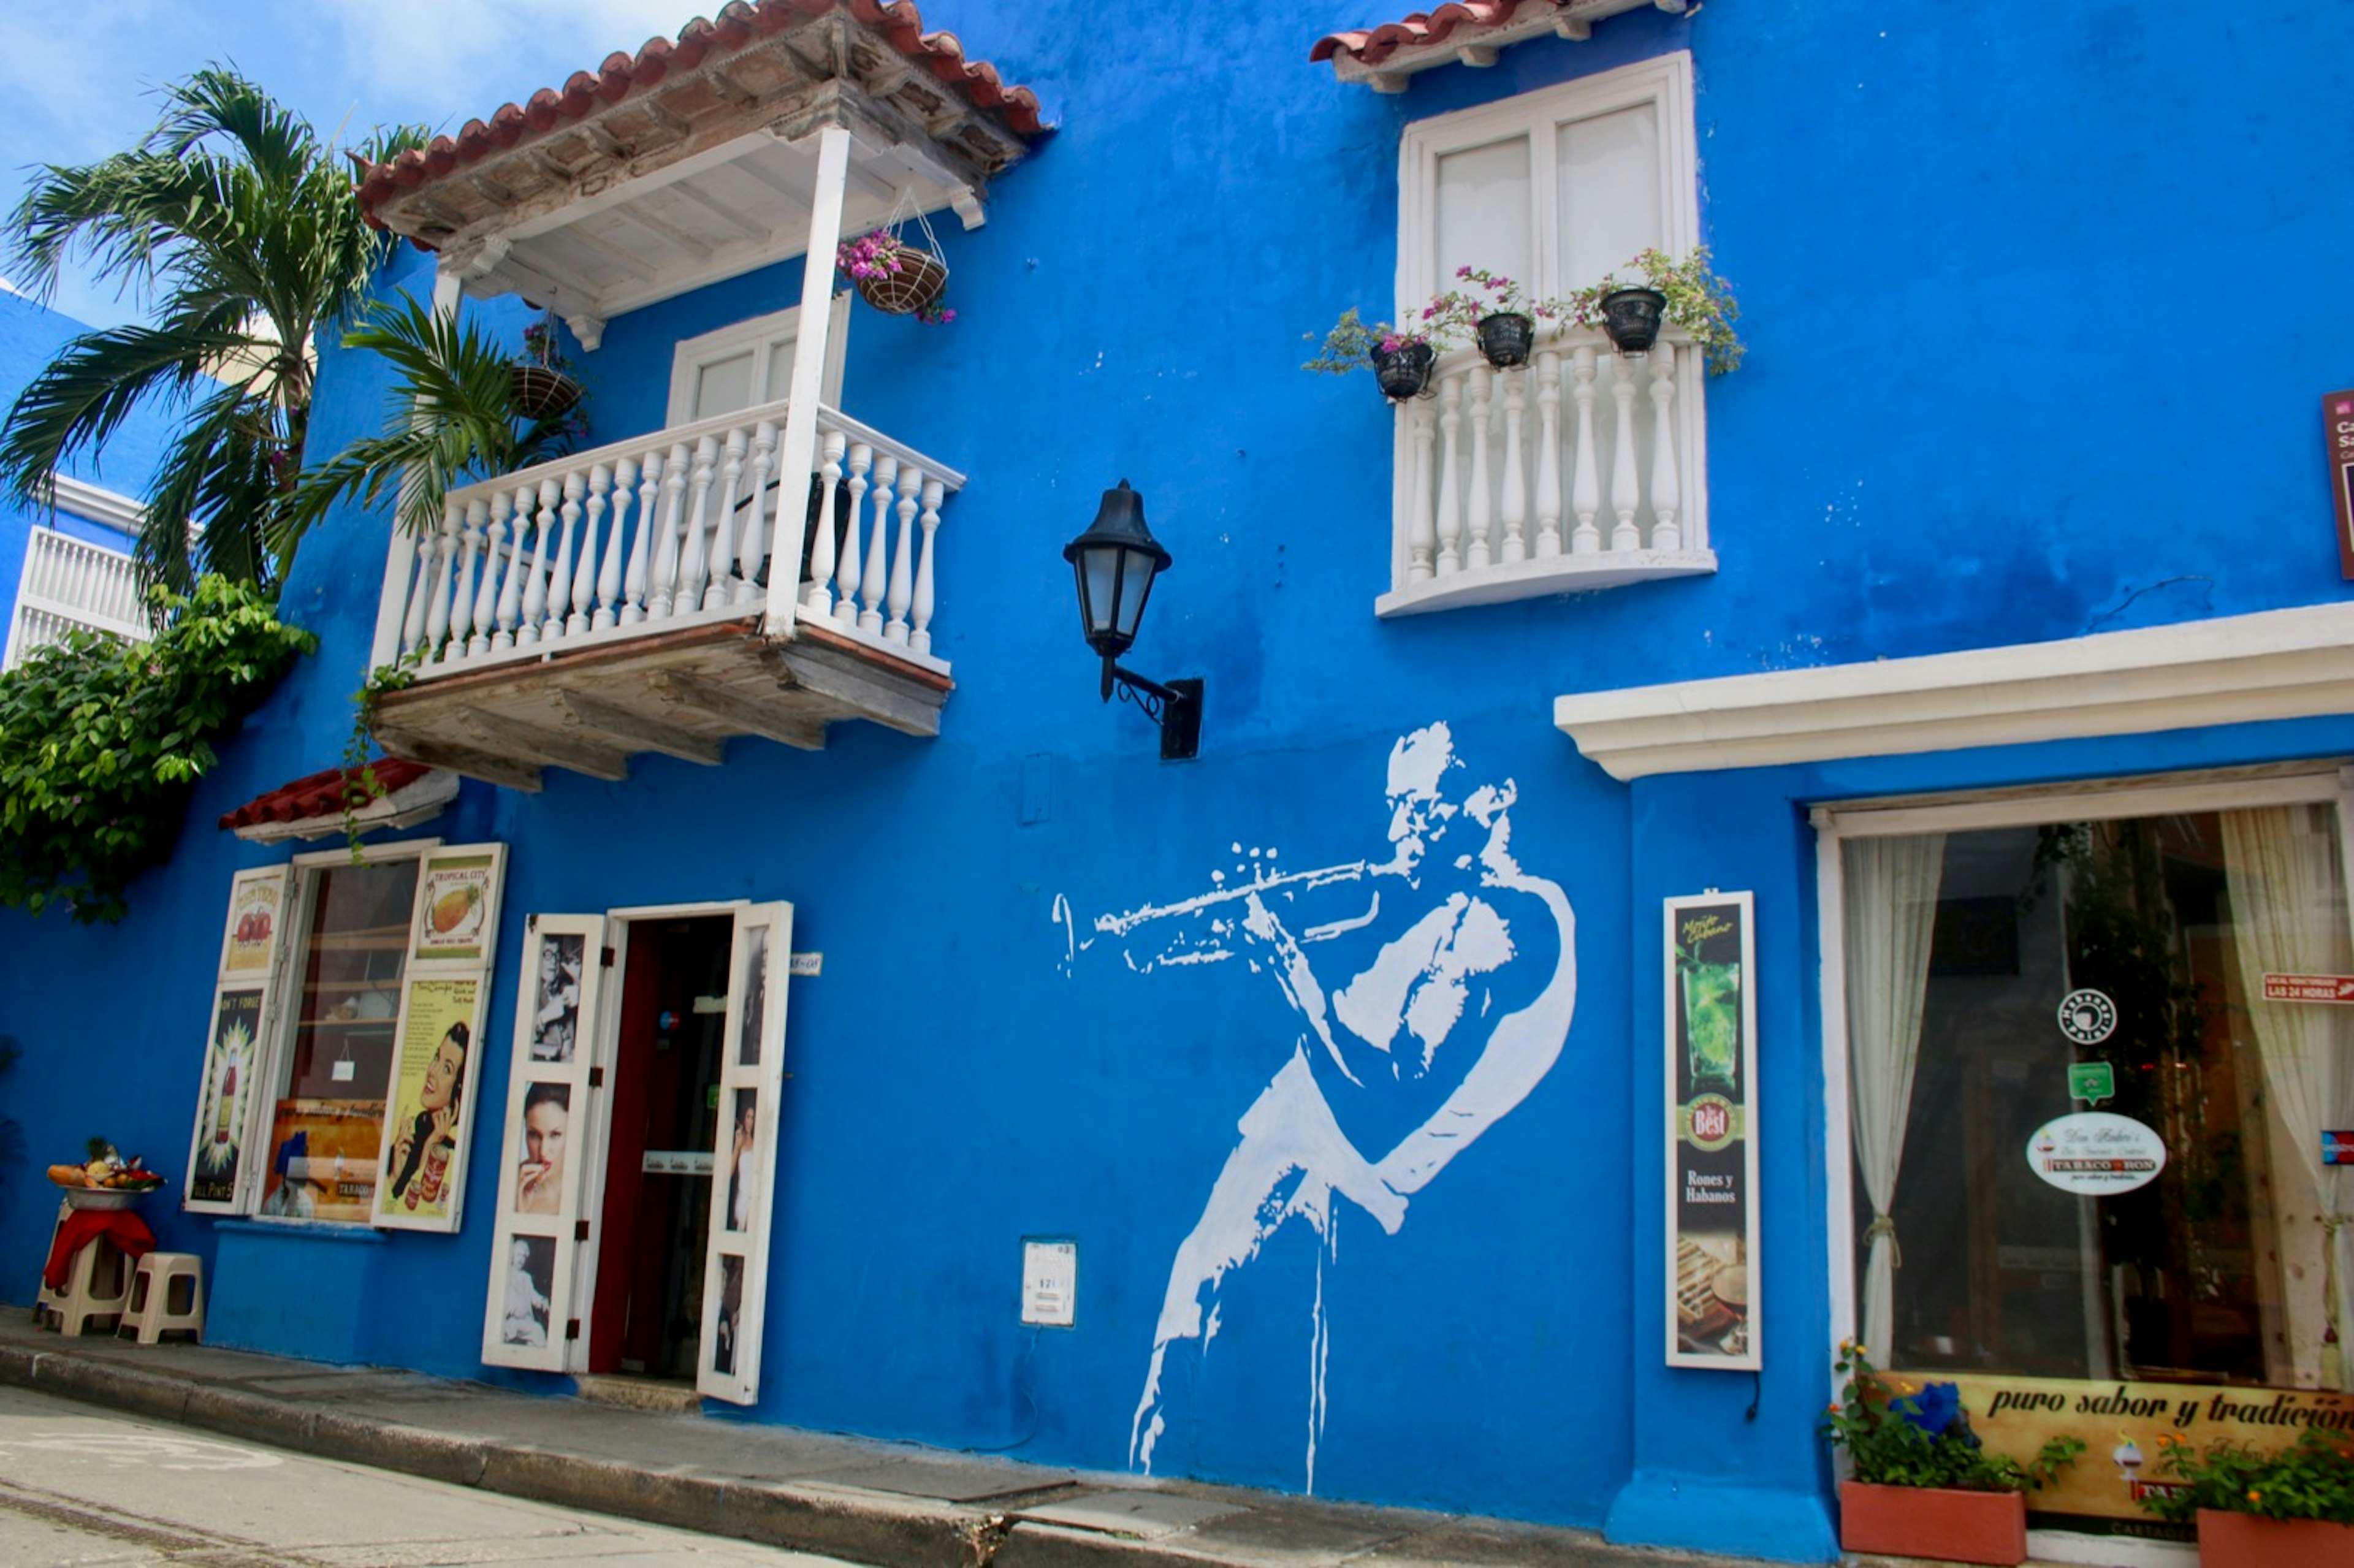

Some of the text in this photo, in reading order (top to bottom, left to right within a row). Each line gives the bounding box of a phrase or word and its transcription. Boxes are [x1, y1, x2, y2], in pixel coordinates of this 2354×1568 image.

[435, 869, 486, 882] TROPICAL CITY
[2268, 986, 2336, 998] LAS 24 HORAS
[1694, 1109, 1726, 1135] Best
[2055, 1160, 2112, 1170] TABACO
[2124, 1160, 2154, 1170] RON
[1688, 1170, 1734, 1189] Rones y
[1686, 1187, 1735, 1203] Habanos
[1987, 1390, 2066, 1418] puro
[2075, 1385, 2168, 1417] sabor
[2173, 1401, 2200, 1428] y
